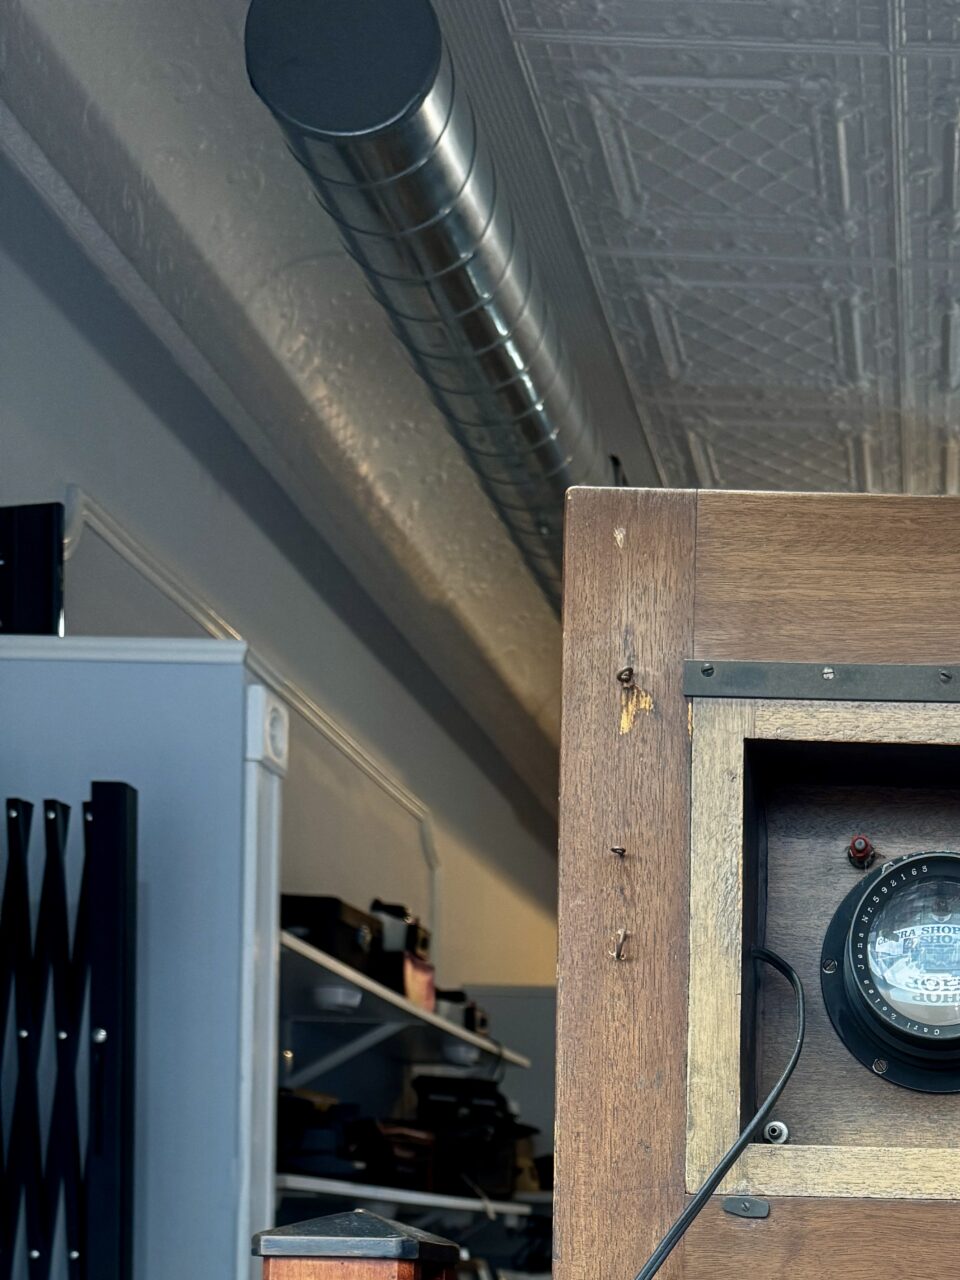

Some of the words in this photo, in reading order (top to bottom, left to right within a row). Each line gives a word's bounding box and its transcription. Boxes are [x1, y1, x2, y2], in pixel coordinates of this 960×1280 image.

[921, 926, 960, 934] SHOP
[857, 932, 865, 970] Jena
[864, 979, 897, 1020] Zeiss
[906, 1022, 940, 1036] Carl
